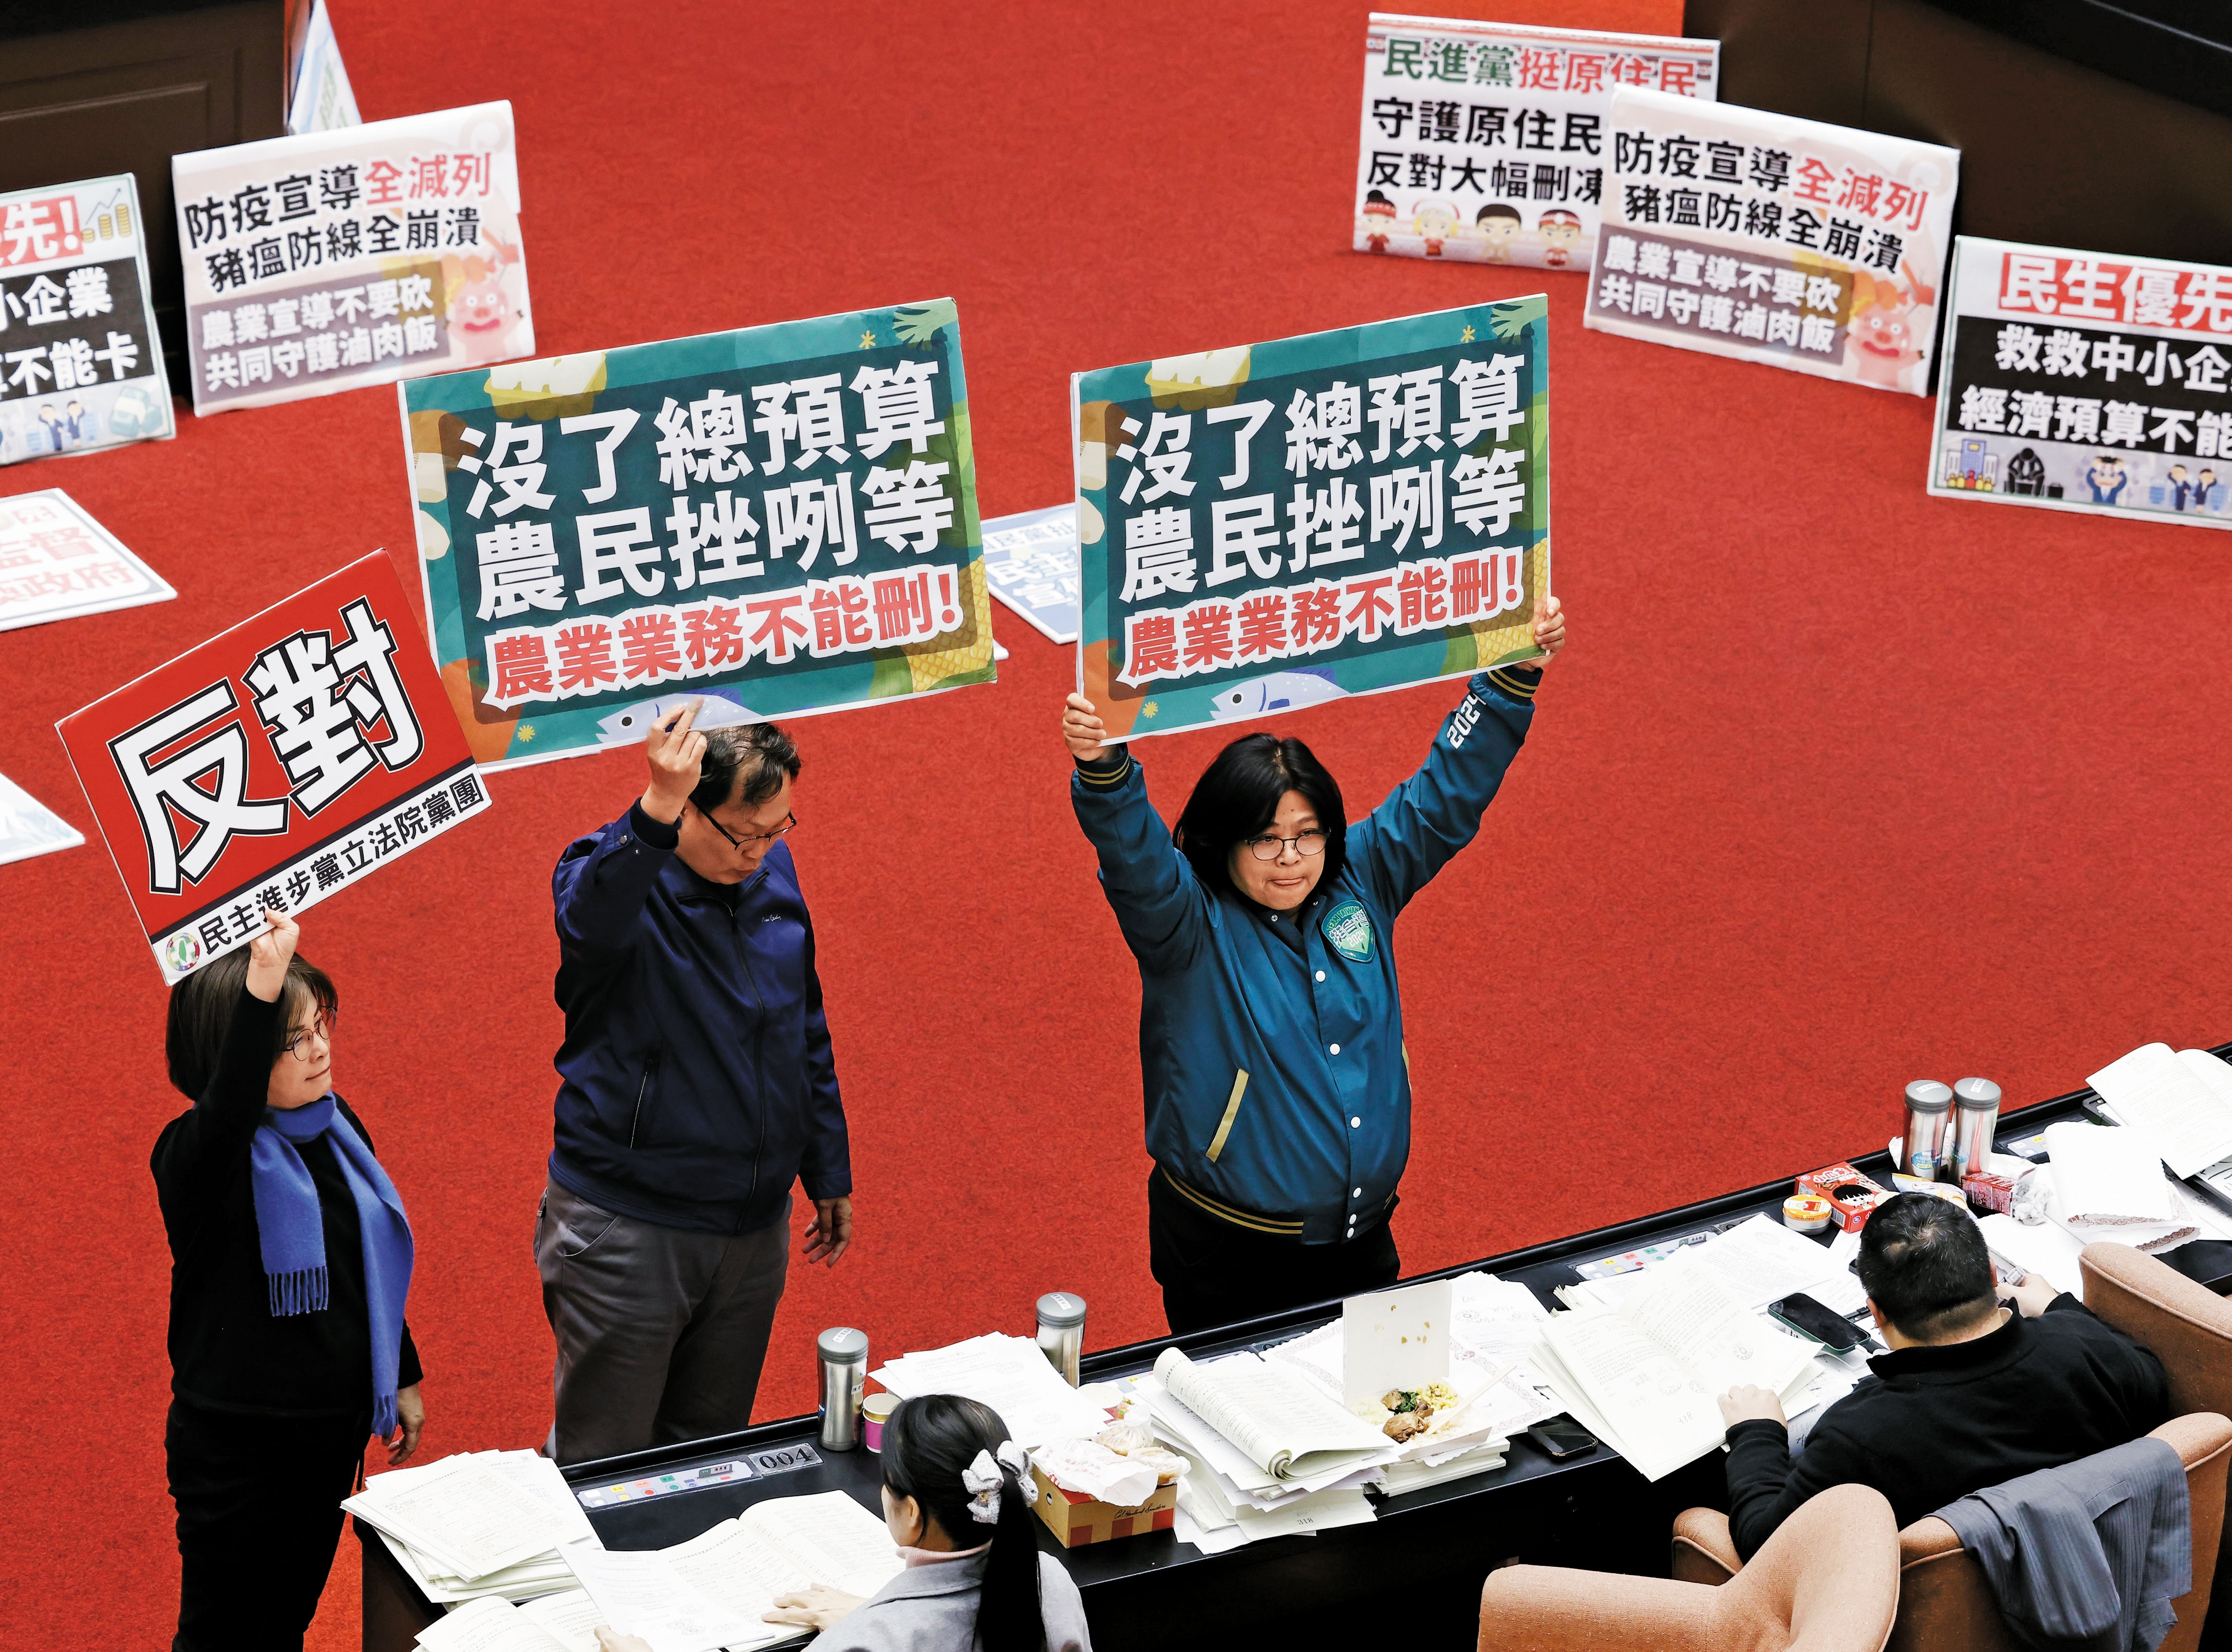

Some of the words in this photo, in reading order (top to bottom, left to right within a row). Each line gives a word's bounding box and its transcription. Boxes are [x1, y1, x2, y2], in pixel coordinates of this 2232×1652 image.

[1382, 38, 1697, 97] 民進黨挺原住民
[1372, 96, 1602, 155] 守護原住民
[183, 152, 492, 249] 防疫宣導全減列
[1614, 131, 1929, 233] 防疫宣導全減列
[0, 199, 83, 267] 先!
[205, 207, 480, 293] 豬瘟防線全崩潰
[1624, 183, 1904, 275] 豬瘟防線全崩潰
[201, 274, 435, 350] 農業宣導不要砍
[1605, 235, 1842, 314] 農業宣導不要砍
[2000, 253, 2232, 332] 民生優先
[205, 316, 438, 392] 共同守護滷肉飯
[1599, 276, 1836, 354] 共同守護滷肉飯
[0, 330, 139, 399] 不能卡
[1995, 323, 2232, 394] 救救中小企
[457, 359, 946, 520] 沒了總預算
[1115, 353, 1526, 505] 沒了總預算
[474, 459, 955, 622] 農民挫咧等
[1118, 447, 1526, 604] 農民挫咧等
[106, 595, 425, 895] 反對
[1446, 692, 1487, 749] 2024
[198, 773, 484, 955] 民主進步黨立法院黨團
[1326, 914, 1341, 931] TEAM
[1337, 906, 1360, 918] TAIWAN
[1346, 929, 1367, 948] 2024
[759, 1448, 813, 1468] 004
